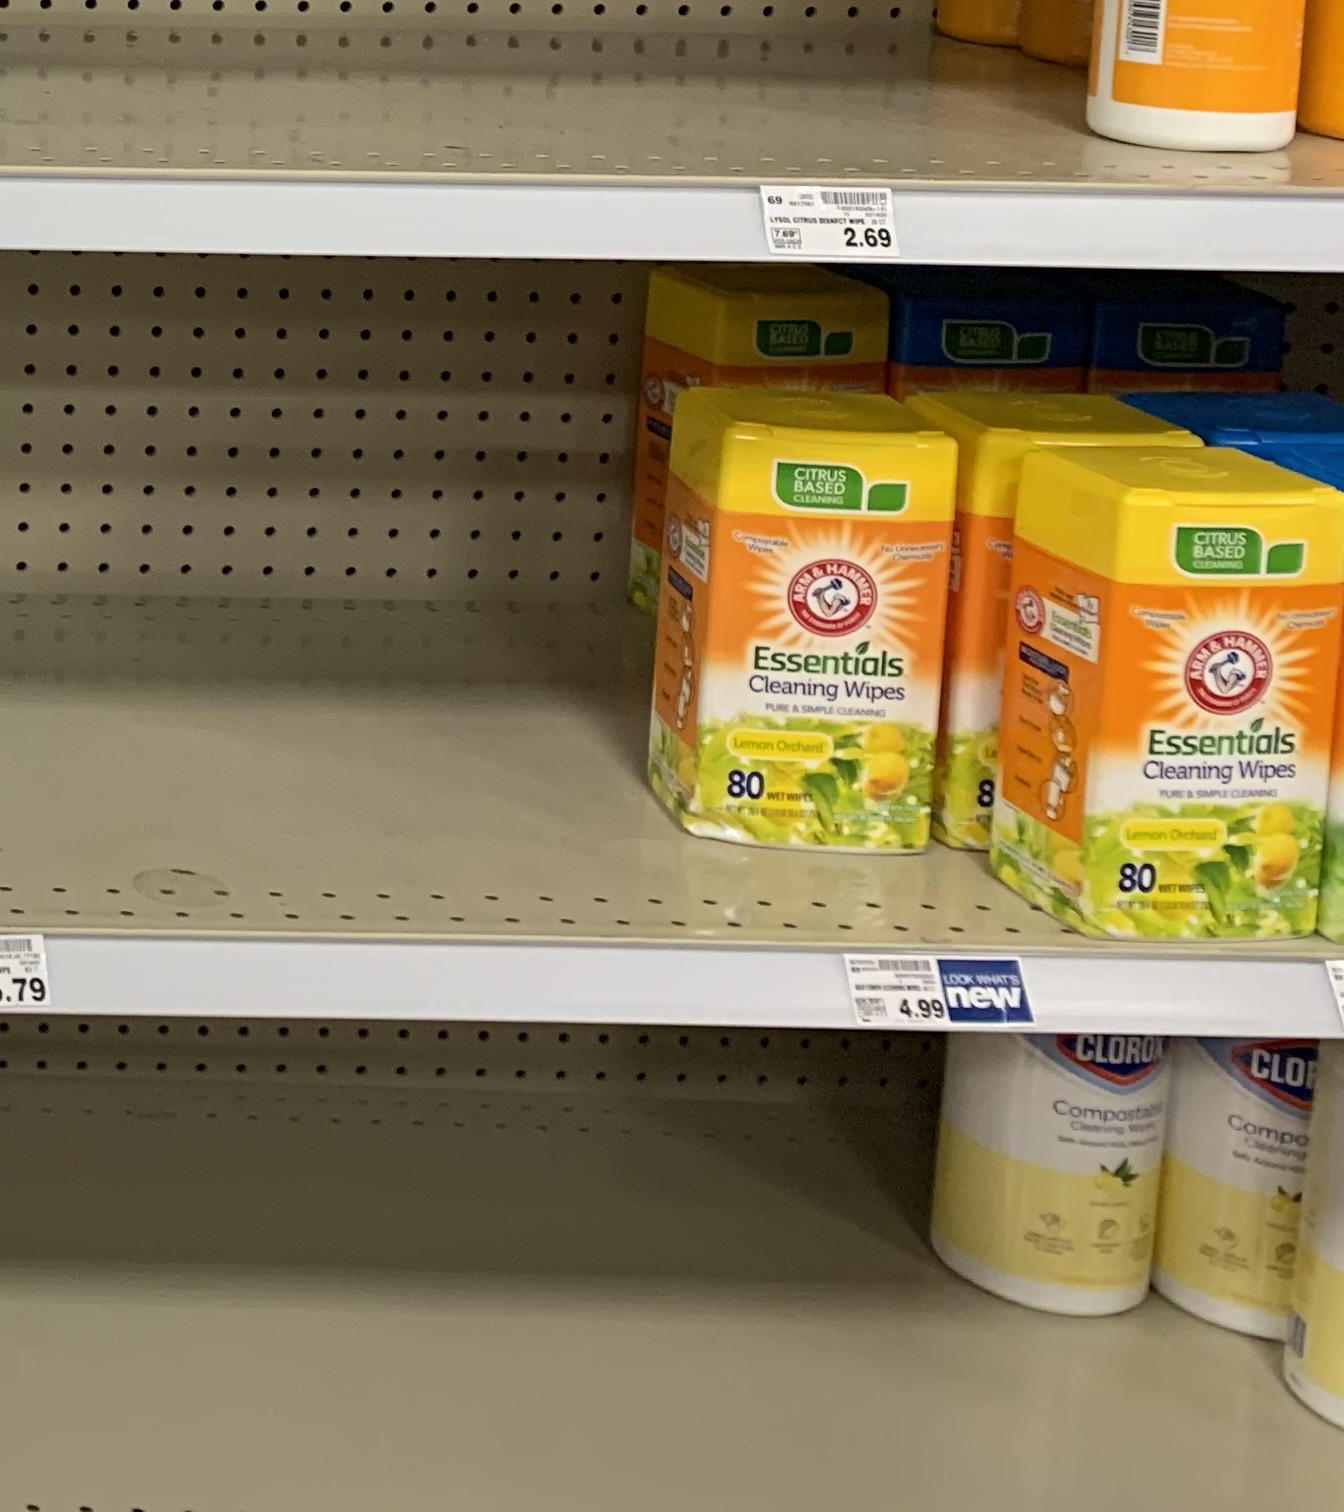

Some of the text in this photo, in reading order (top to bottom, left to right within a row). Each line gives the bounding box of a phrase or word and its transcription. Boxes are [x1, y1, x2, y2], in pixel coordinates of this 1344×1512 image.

[767, 195, 783, 205] 69
[792, 216, 818, 224] CITRUS
[843, 227, 892, 248] 2.69
[794, 467, 847, 483] CITRUS
[793, 480, 846, 495] BASED
[793, 494, 844, 506] CLEANING
[1193, 531, 1247, 546] CITRUS
[1193, 545, 1245, 560] BASED
[793, 563, 872, 606] ARM & HAMMER
[753, 644, 905, 678] Essentials
[1189, 636, 1268, 681] ARM & HAMMER
[749, 674, 906, 704] Cleaning Wipes
[765, 702, 886, 719] PURE & SIMPLE CLEANING
[733, 737, 824, 754] Lemon Orchard
[1148, 725, 1296, 757] Essentials
[1143, 760, 1297, 785] Cleaning Wipes
[726, 769, 765, 801] 80
[1159, 789, 1186, 799] PURE
[1196, 788, 1228, 799] SIMPLE
[1231, 788, 1279, 798] CLEANING
[1118, 862, 1157, 894] 80
[943, 973, 1020, 986] LOOK WHAT'S
[899, 998, 945, 1019] 4.99
[945, 986, 1021, 1010] new
[1227, 1113, 1310, 1148] Compo
